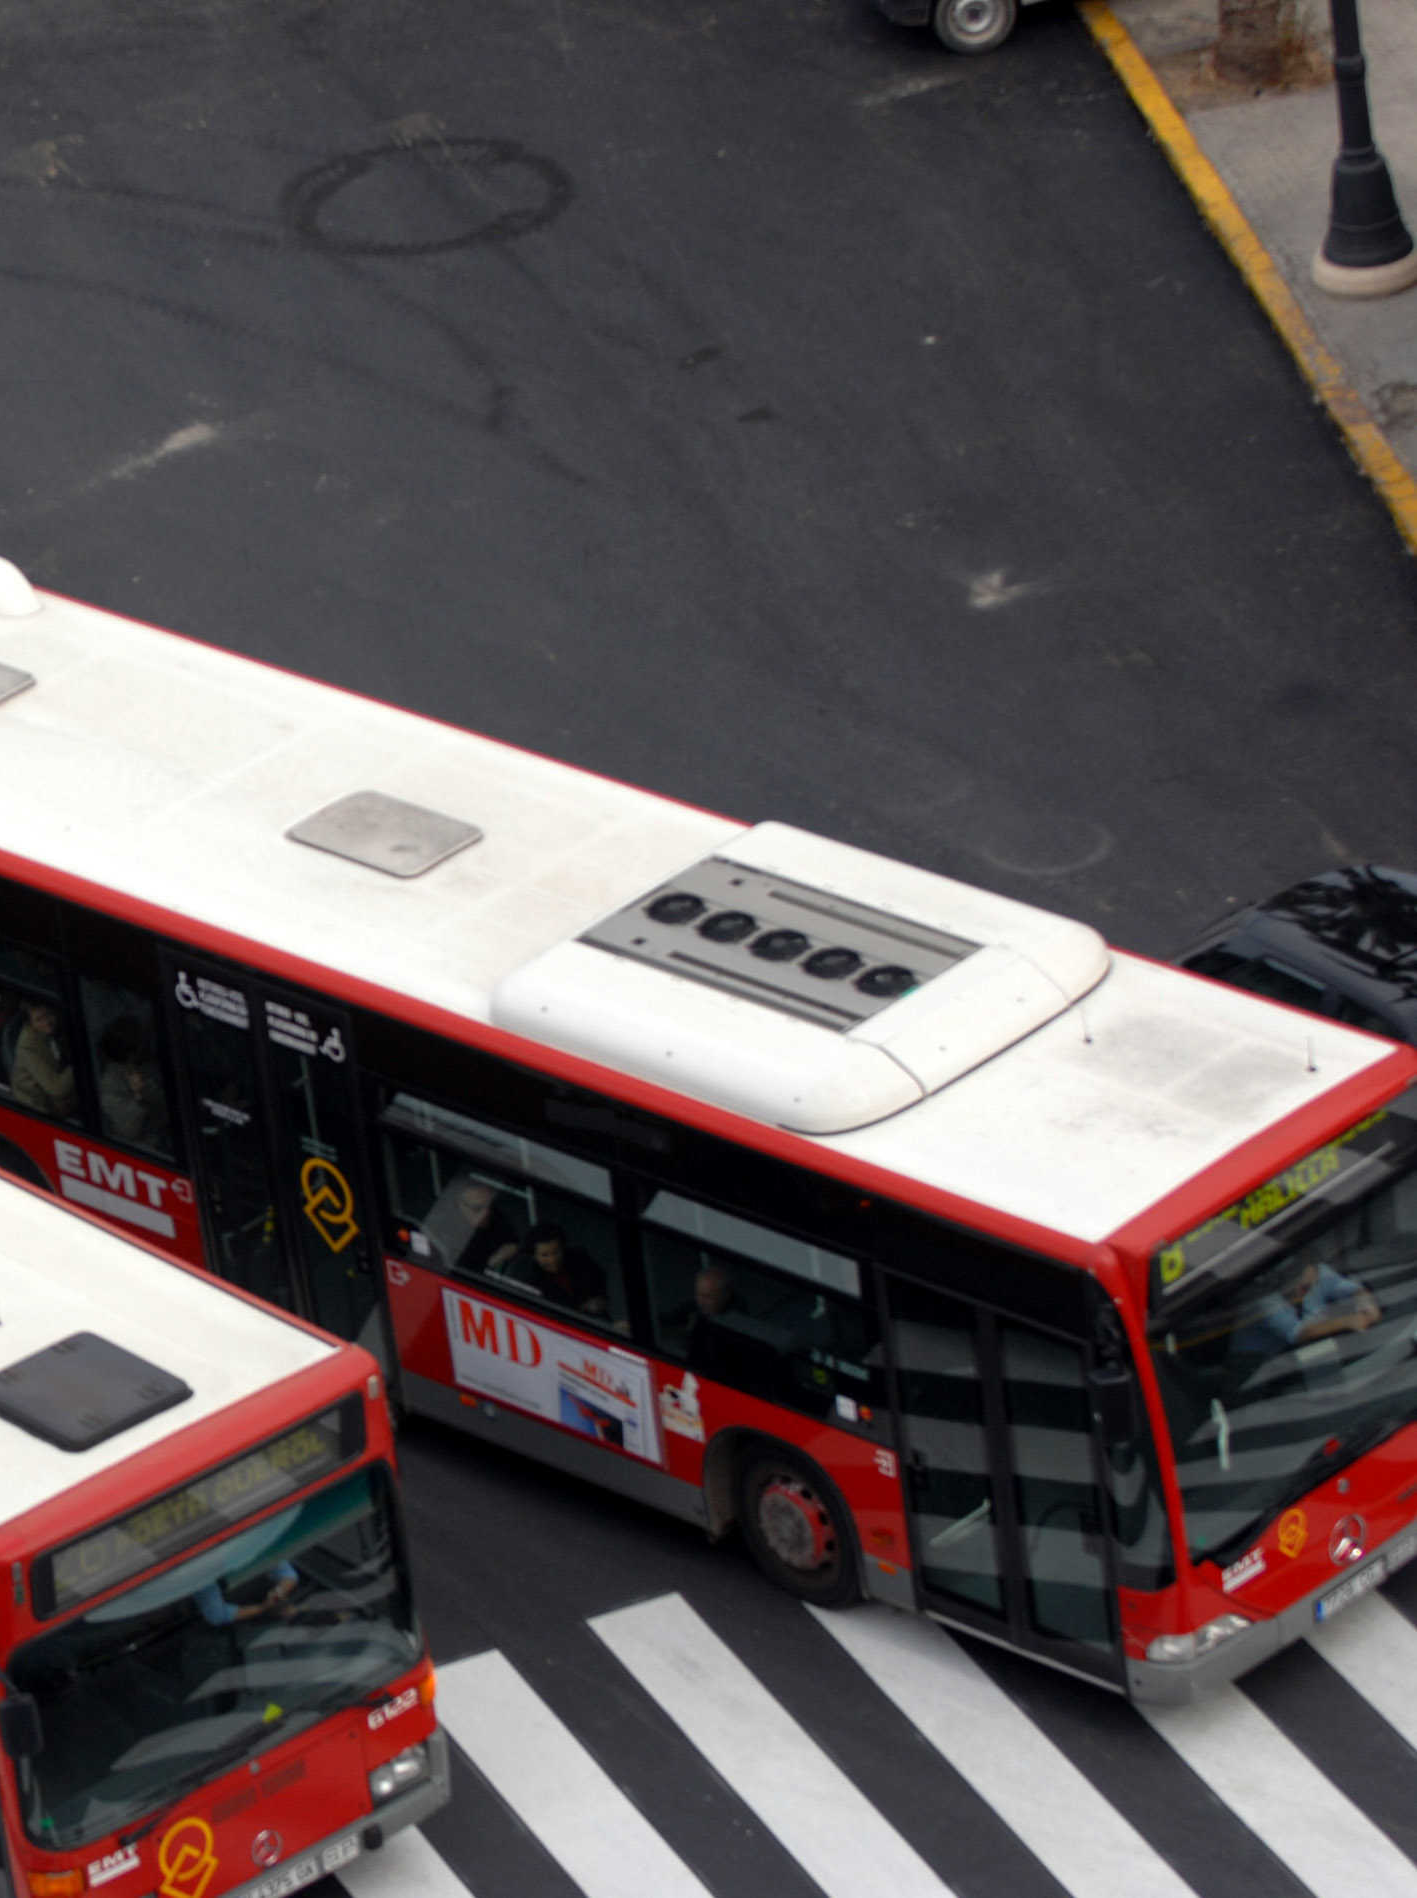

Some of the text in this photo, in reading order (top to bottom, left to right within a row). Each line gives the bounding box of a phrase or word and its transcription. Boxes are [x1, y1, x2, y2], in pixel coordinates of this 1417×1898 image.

[53, 1138, 168, 1208] EMT
[458, 1299, 542, 1369] MD
[1222, 1548, 1263, 1583] EMT
[87, 1843, 137, 1875] EMT
